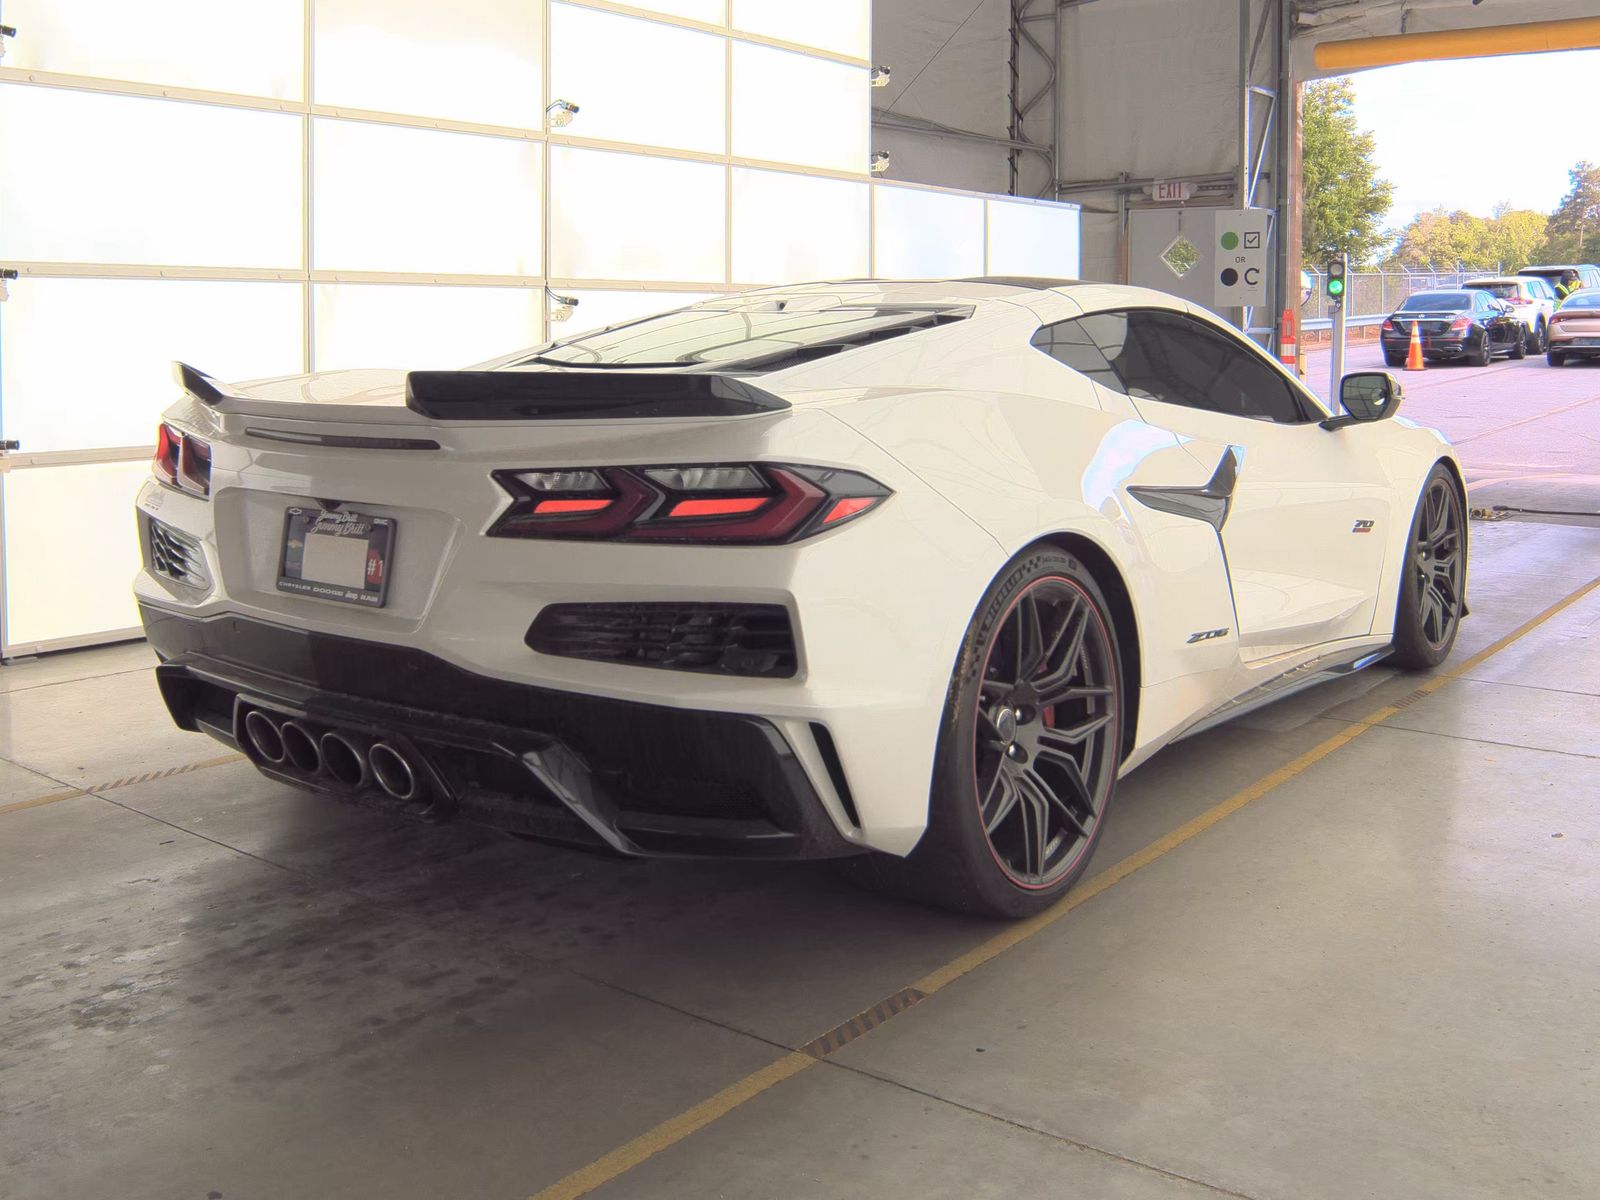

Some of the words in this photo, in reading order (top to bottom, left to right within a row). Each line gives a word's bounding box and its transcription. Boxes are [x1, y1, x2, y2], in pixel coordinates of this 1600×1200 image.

[1158, 183, 1182, 199] EXIT
[367, 559, 383, 577] #1
[279, 581, 311, 591] CHRYSLER
[313, 587, 343, 596] DODGE
[1186, 627, 1230, 644] Z06
